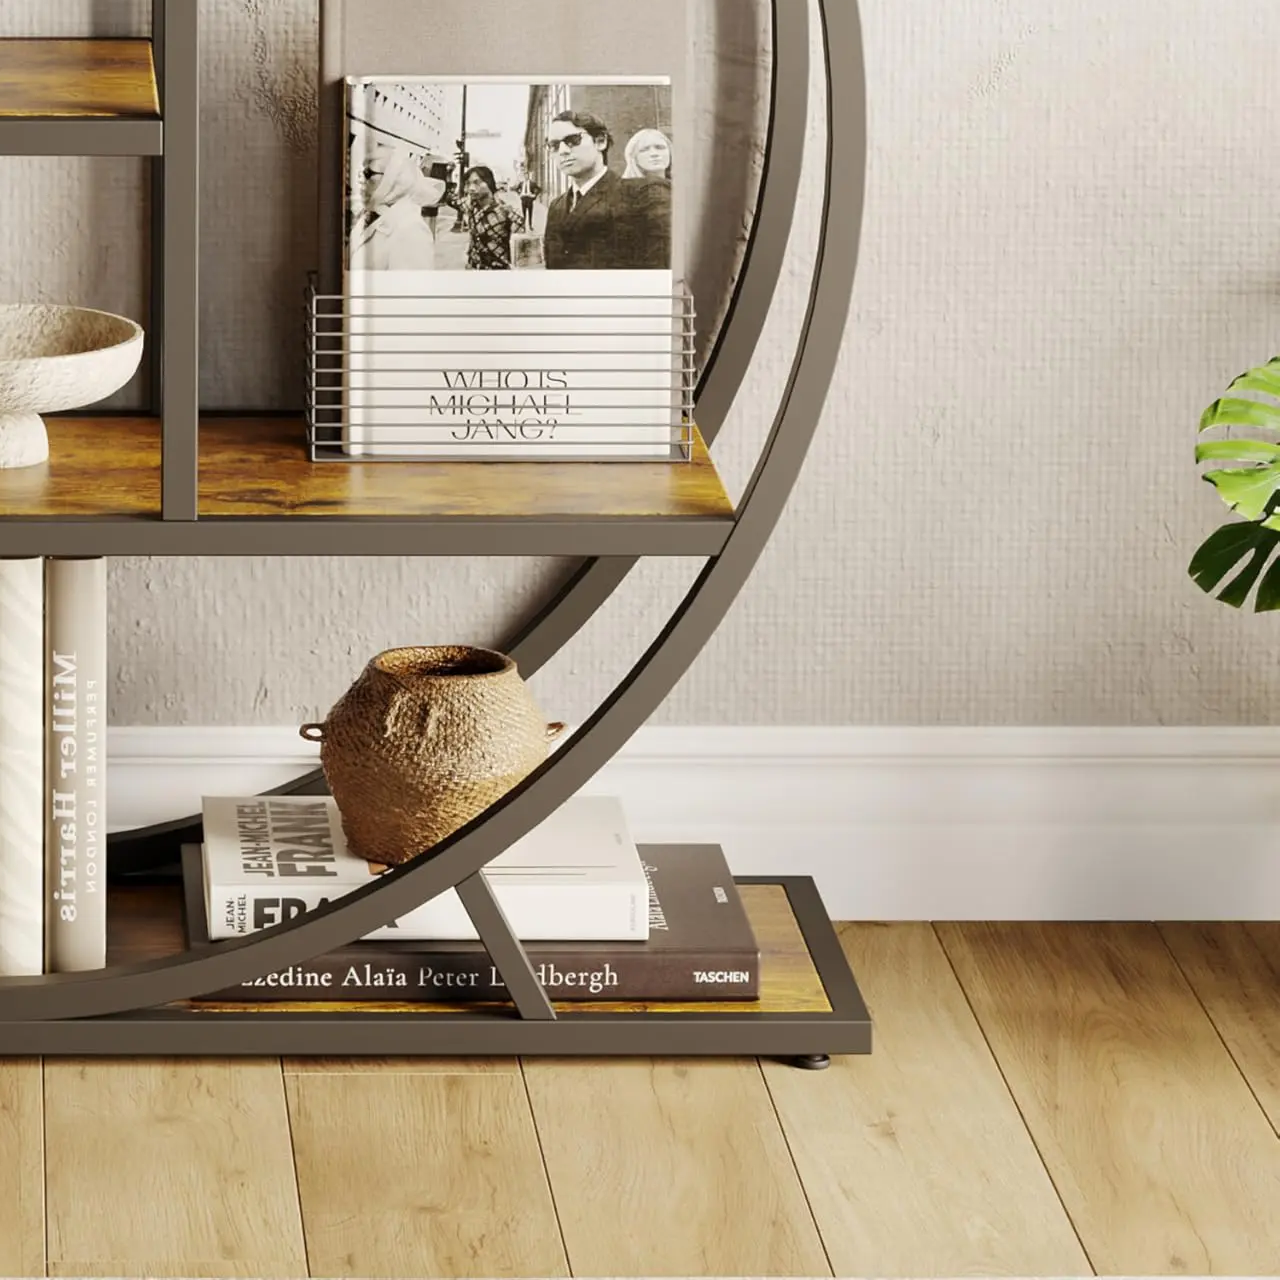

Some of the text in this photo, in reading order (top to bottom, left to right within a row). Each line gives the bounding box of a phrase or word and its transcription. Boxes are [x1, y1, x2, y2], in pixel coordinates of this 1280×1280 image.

[442, 370, 568, 389] WHO IS
[429, 393, 583, 416] MICHAEL
[451, 417, 558, 441] JANG?
[236, 801, 275, 877] JEAN-MICHEL
[269, 801, 337, 877] FRANK
[238, 894, 246, 933] MICHEL
[341, 964, 408, 987] Alaïa
[417, 967, 480, 987] Peter
[489, 964, 619, 993] Ldbergh
[693, 971, 749, 983] TASCHEN
